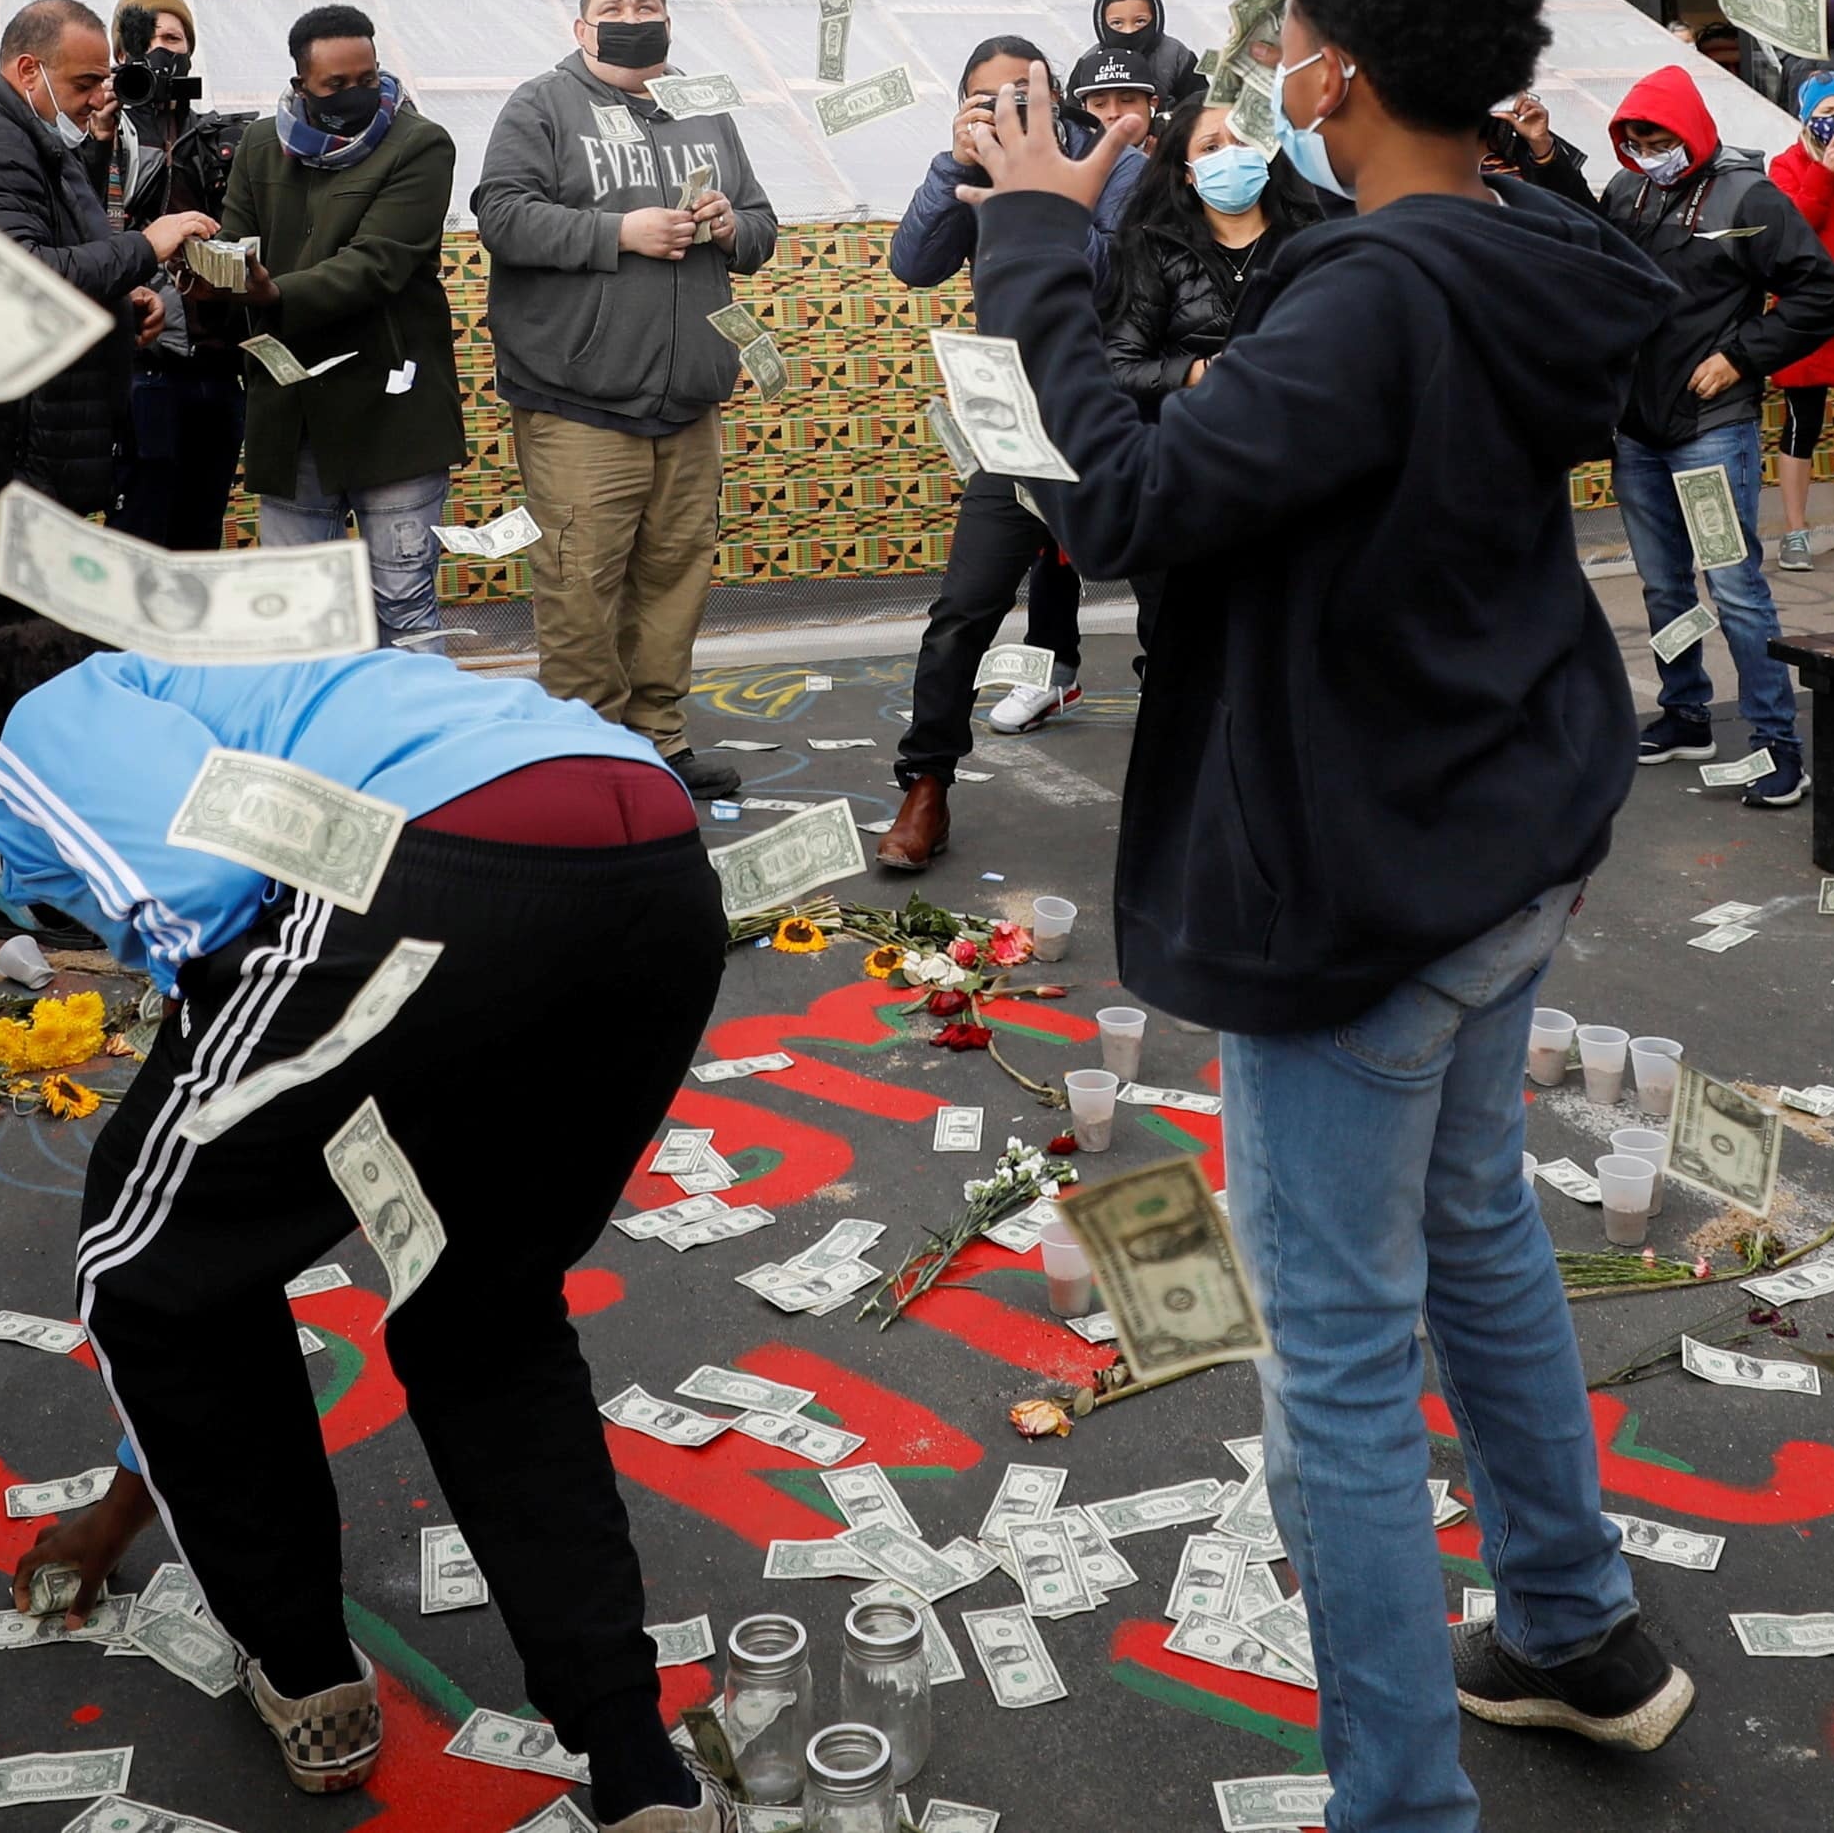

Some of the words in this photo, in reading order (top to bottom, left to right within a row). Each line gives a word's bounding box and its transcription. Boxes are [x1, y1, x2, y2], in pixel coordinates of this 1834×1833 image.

[1098, 64, 1126, 74] CAN'T
[1094, 72, 1131, 83] BREATHE
[241, 793, 315, 849] ONE
